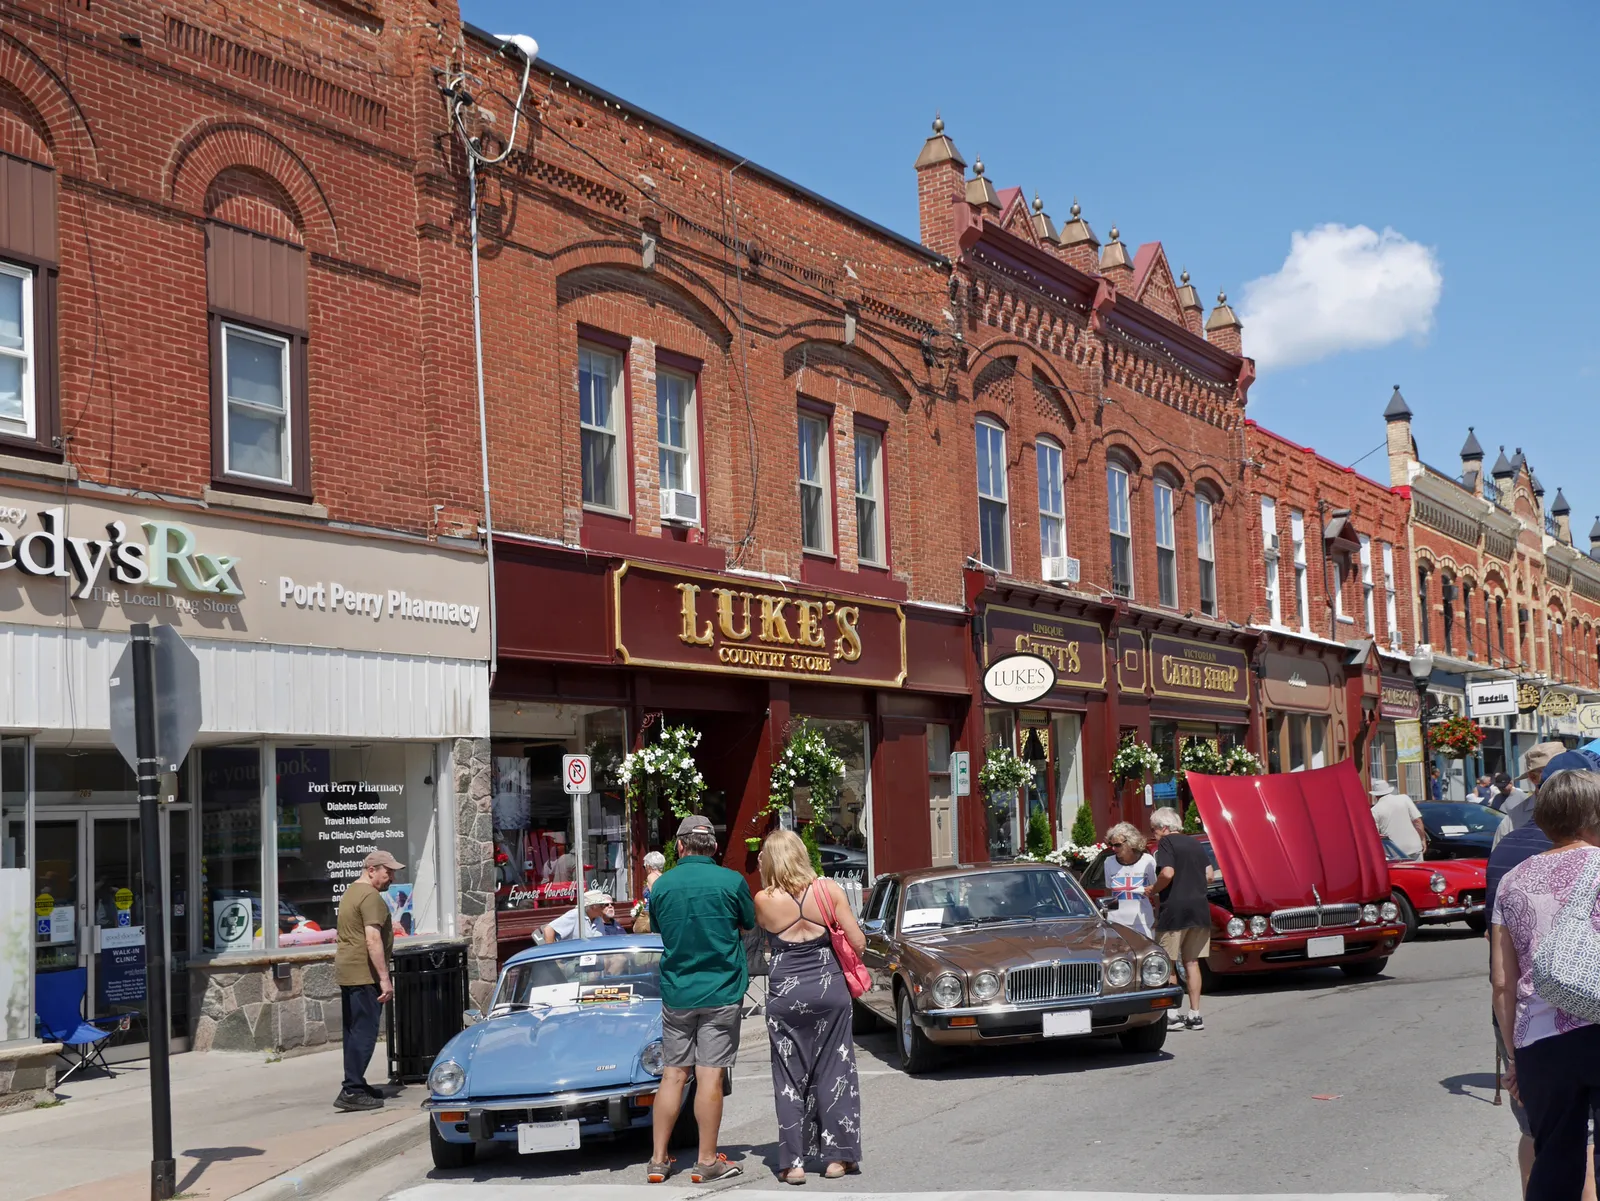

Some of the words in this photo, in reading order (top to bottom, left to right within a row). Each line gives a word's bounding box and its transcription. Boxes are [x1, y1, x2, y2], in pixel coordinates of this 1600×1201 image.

[92, 587, 120, 604] The
[124, 590, 161, 607] Local
[165, 594, 200, 614] Drug
[203, 598, 238, 614] Store
[279, 576, 326, 610] Port
[330, 582, 384, 620] Perry
[387, 589, 480, 630] Pharmacy
[674, 582, 862, 661] LUKE'S
[1033, 623, 1064, 637] UNIQUE
[719, 647, 787, 668] COUNTRY
[791, 654, 832, 672] STORE
[1183, 649, 1217, 661] VICTORIAN
[994, 668, 1046, 687] LUKE'S
[1162, 655, 1202, 688] CARD
[1204, 666, 1239, 692] SHOP
[308, 781, 329, 793] Port
[331, 781, 357, 795] Perry
[359, 781, 405, 795] Pharmacy
[327, 802, 357, 811] Diabetes
[358, 801, 388, 810] Educator
[324, 817, 345, 825] Travel
[346, 816, 368, 825] Health
[369, 815, 391, 824] Clinics
[318, 831, 330, 840] Flu
[331, 830, 384, 840] Clinics/Shingles
[385, 829, 404, 838] Shots
[340, 845, 355, 854] Foot
[356, 845, 378, 853] Clinics
[327, 859, 365, 869] Cholesterol
[330, 869, 344, 878] and
[345, 870, 361, 878] Hear
[508, 883, 540, 906] Express
[543, 881, 576, 902] Yourself
[113, 948, 140, 956] WALK-IN
